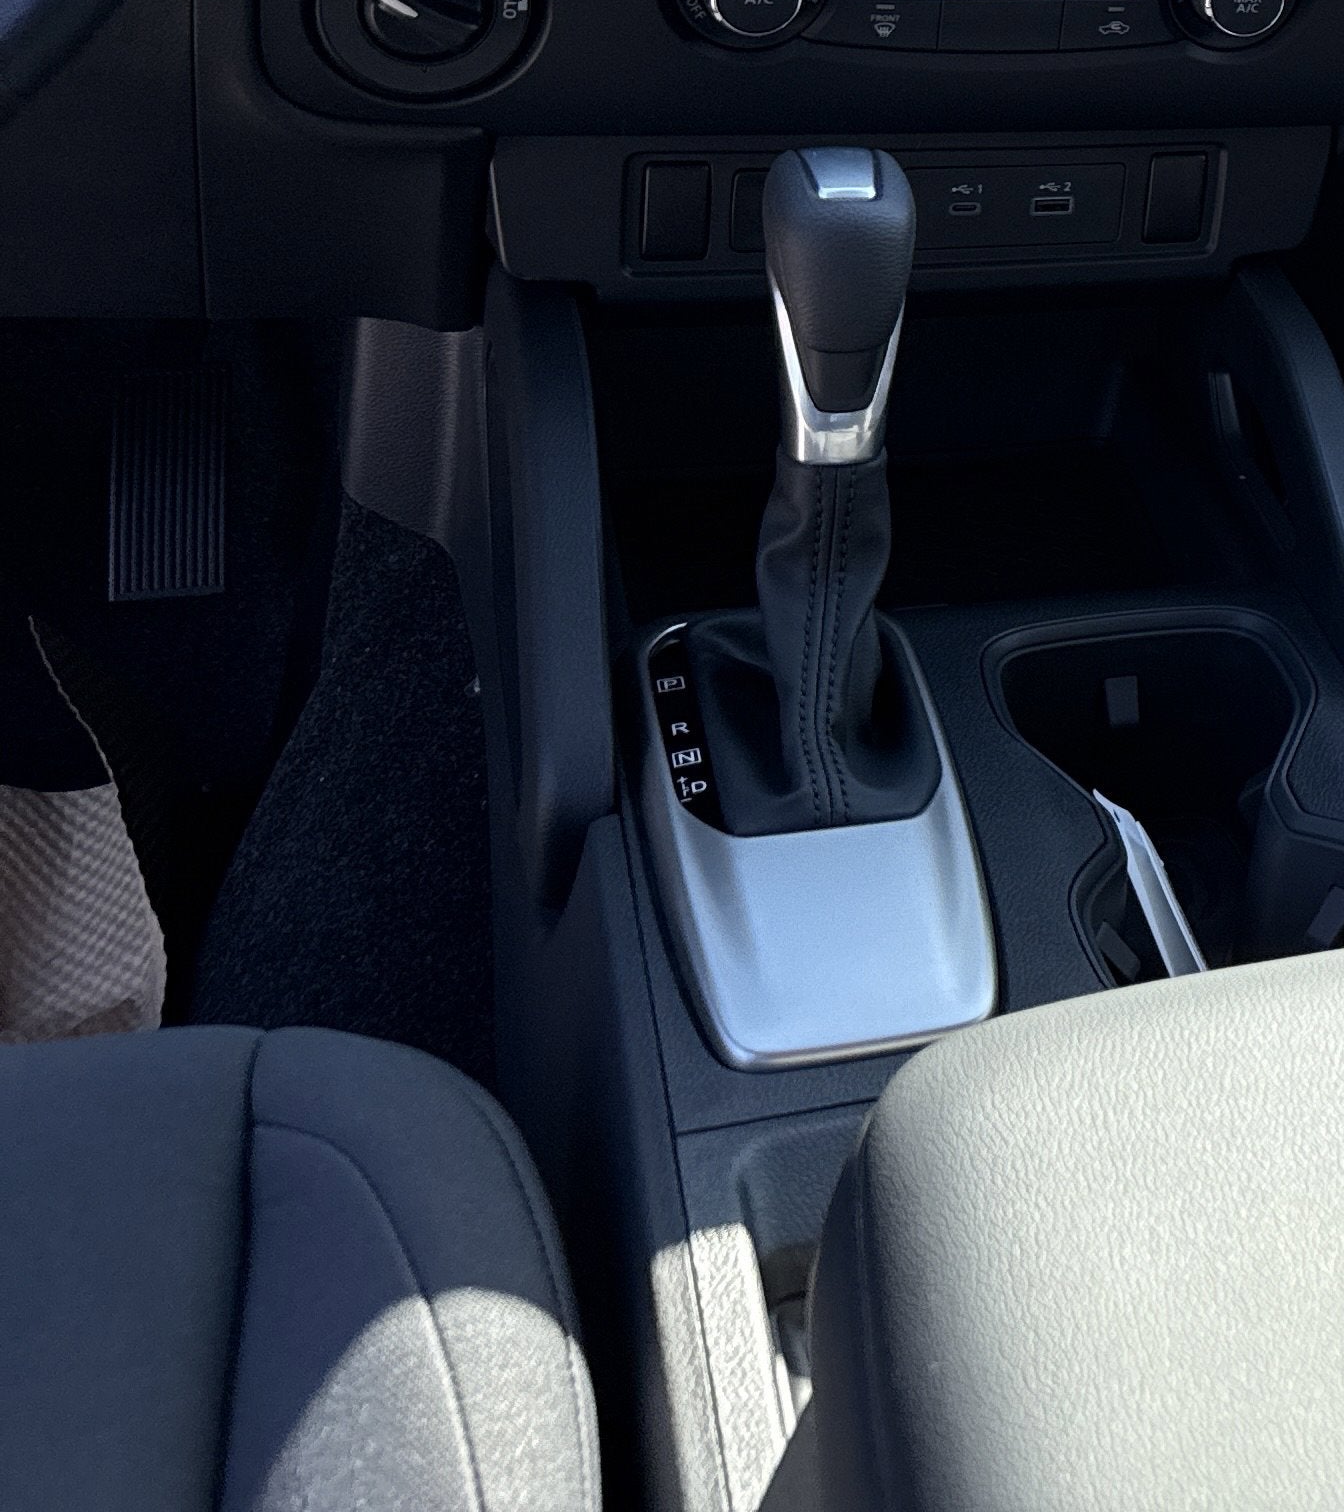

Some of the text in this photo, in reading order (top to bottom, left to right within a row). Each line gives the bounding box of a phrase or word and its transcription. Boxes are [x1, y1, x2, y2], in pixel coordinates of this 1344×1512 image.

[1236, 2, 1259, 15] A/C
[869, 13, 900, 23] FRONT
[1063, 181, 1072, 191] 2
[672, 722, 690, 737] R
[691, 781, 707, 794] D
